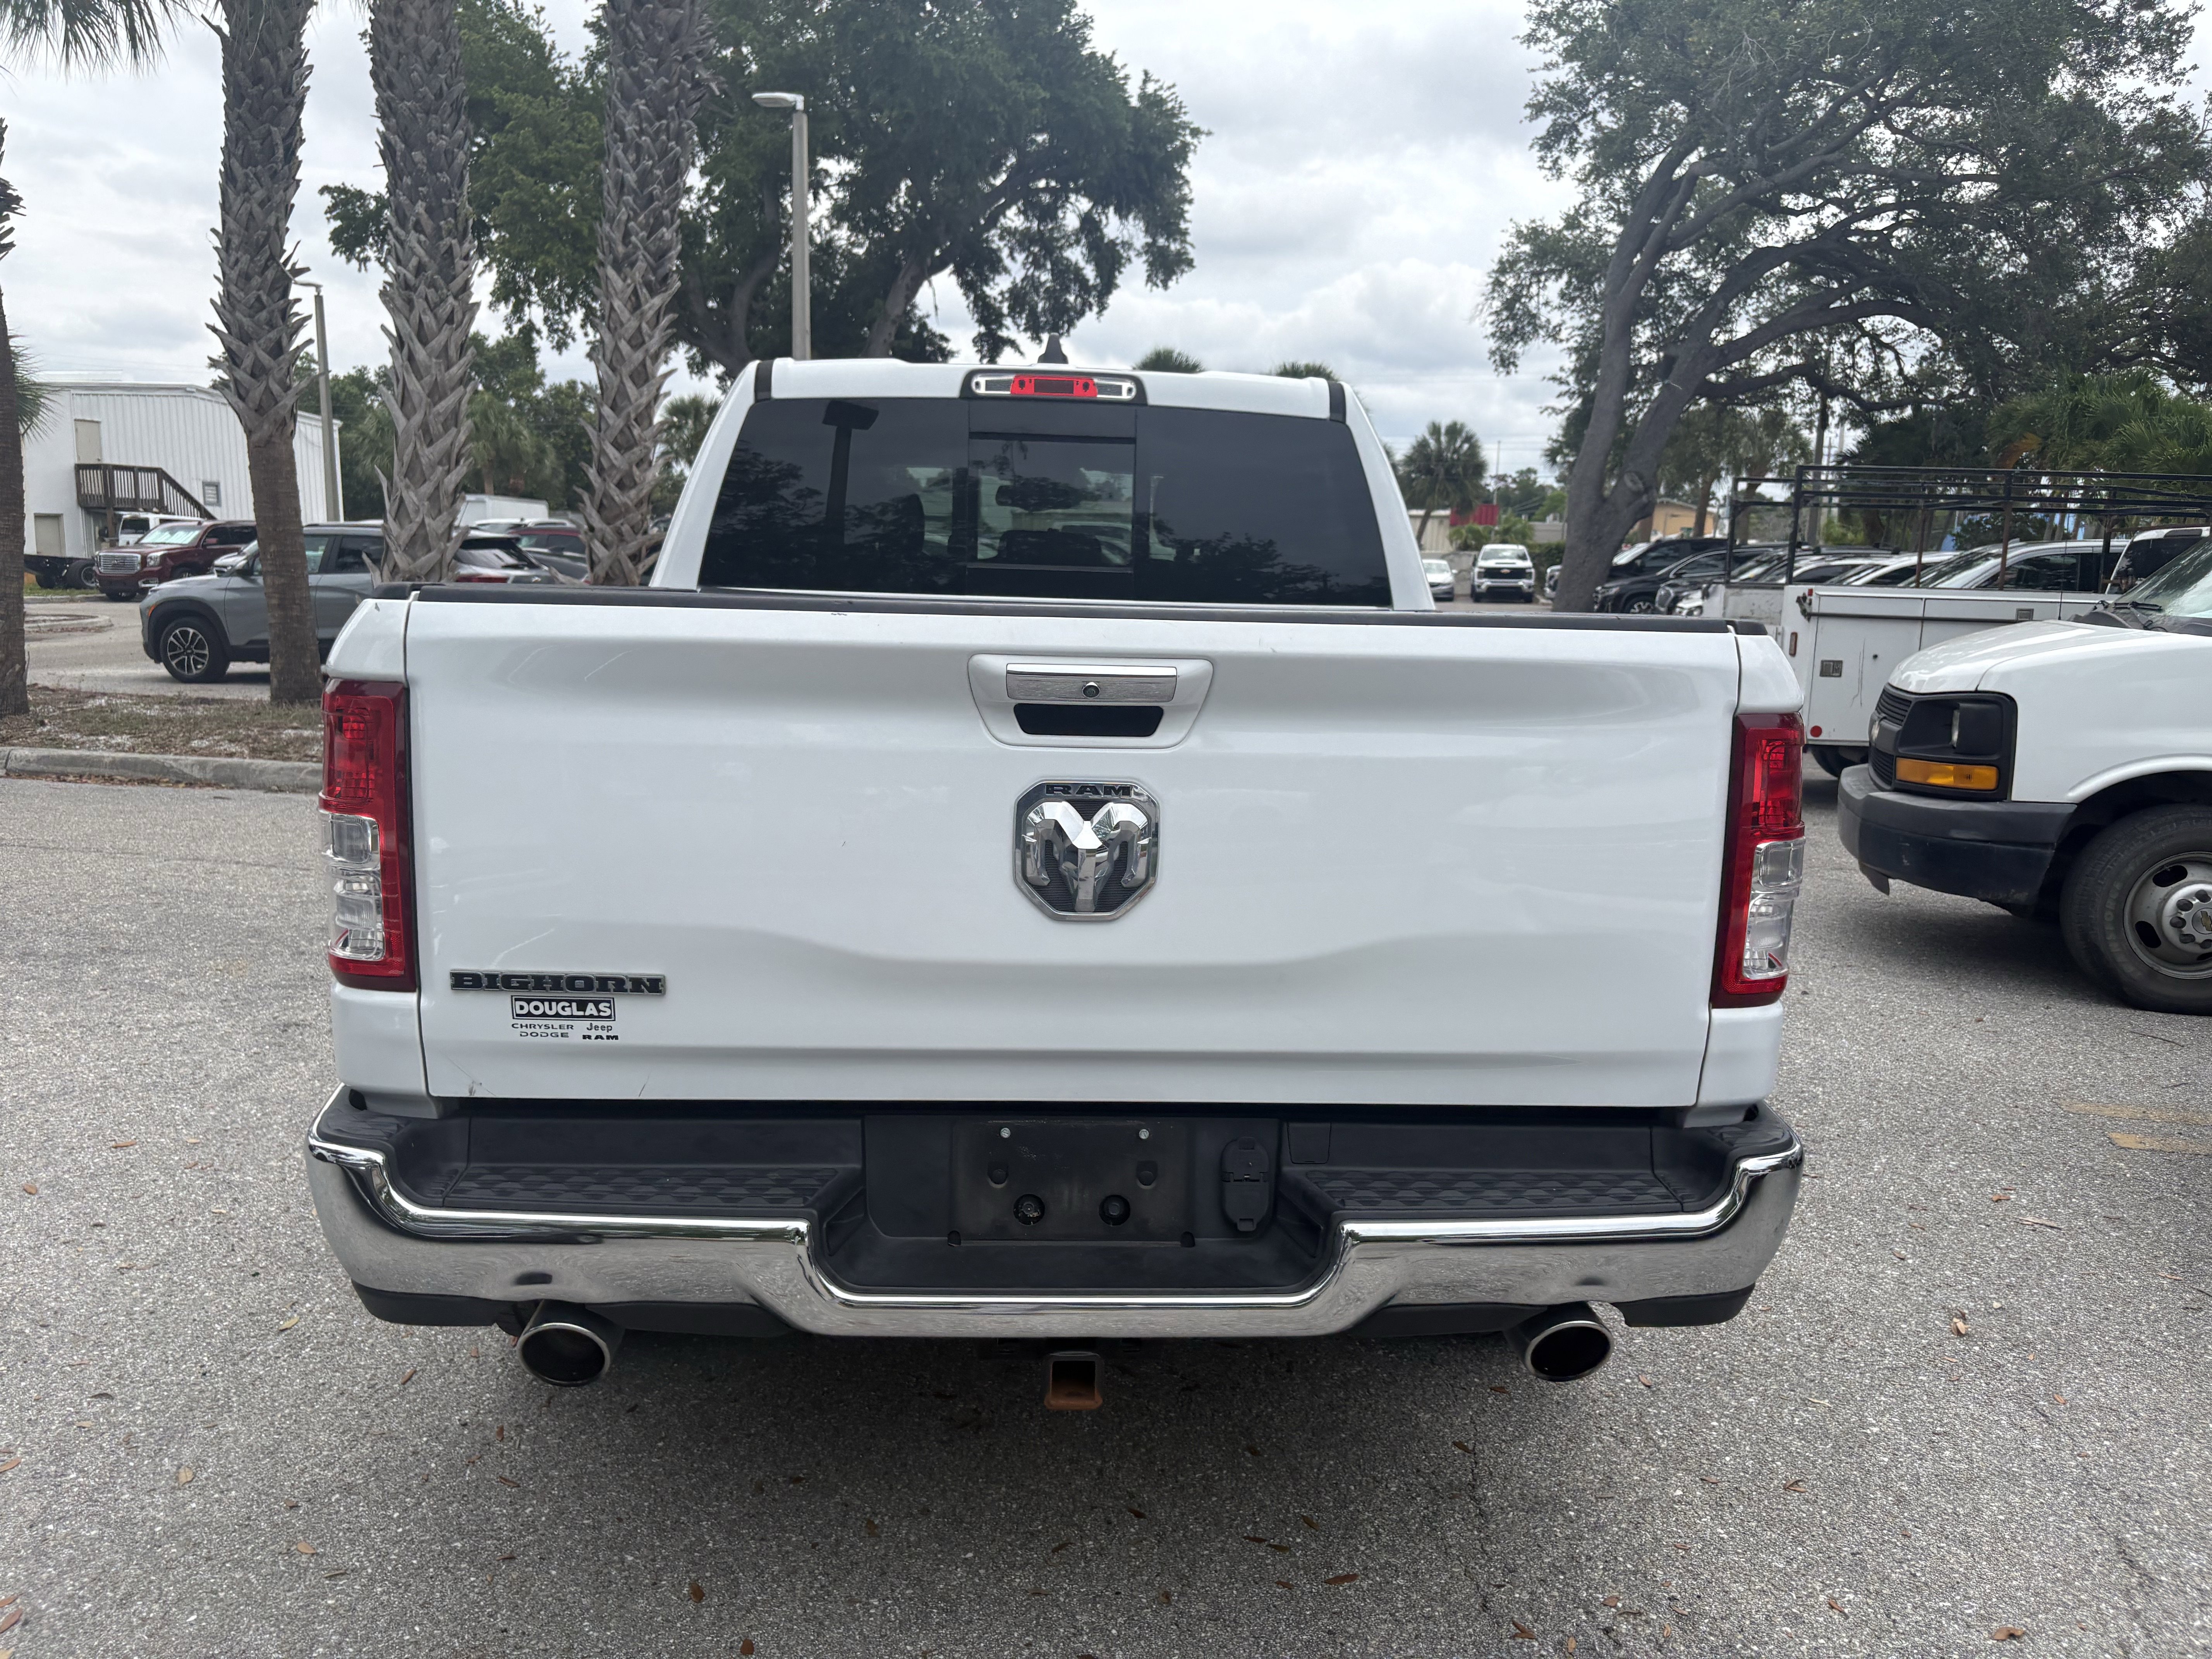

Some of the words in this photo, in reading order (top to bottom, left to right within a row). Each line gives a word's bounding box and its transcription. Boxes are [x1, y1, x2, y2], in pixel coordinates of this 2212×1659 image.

[1045, 784, 1131, 797] RAM
[450, 969, 665, 995] BIGHORN
[515, 1001, 611, 1016] DOUGLAS
[587, 1023, 612, 1032] Jeep
